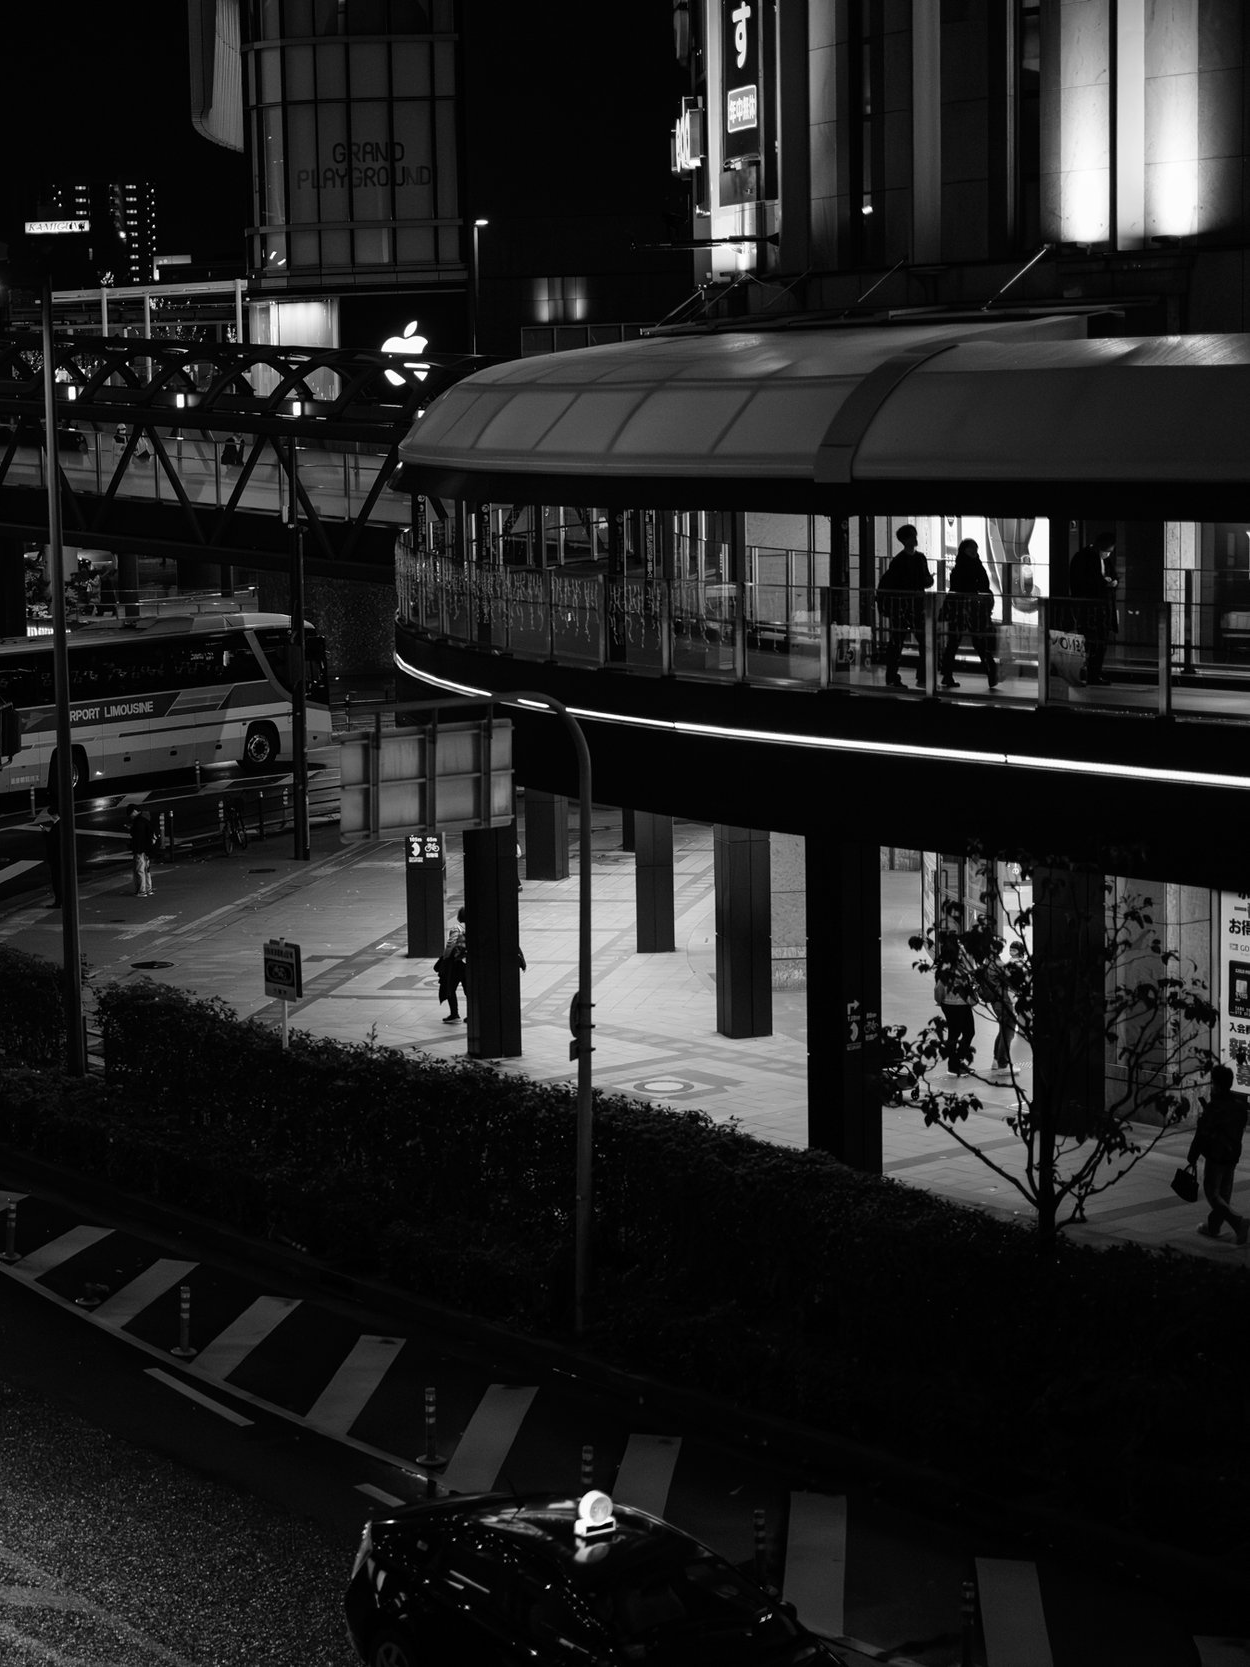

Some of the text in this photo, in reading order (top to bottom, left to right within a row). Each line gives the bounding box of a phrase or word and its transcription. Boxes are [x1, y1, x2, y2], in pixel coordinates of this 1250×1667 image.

[332, 141, 405, 164] GRAND
[297, 166, 432, 190] PLAYGROUND
[69, 701, 154, 722] RPORT LIMOUSINE
